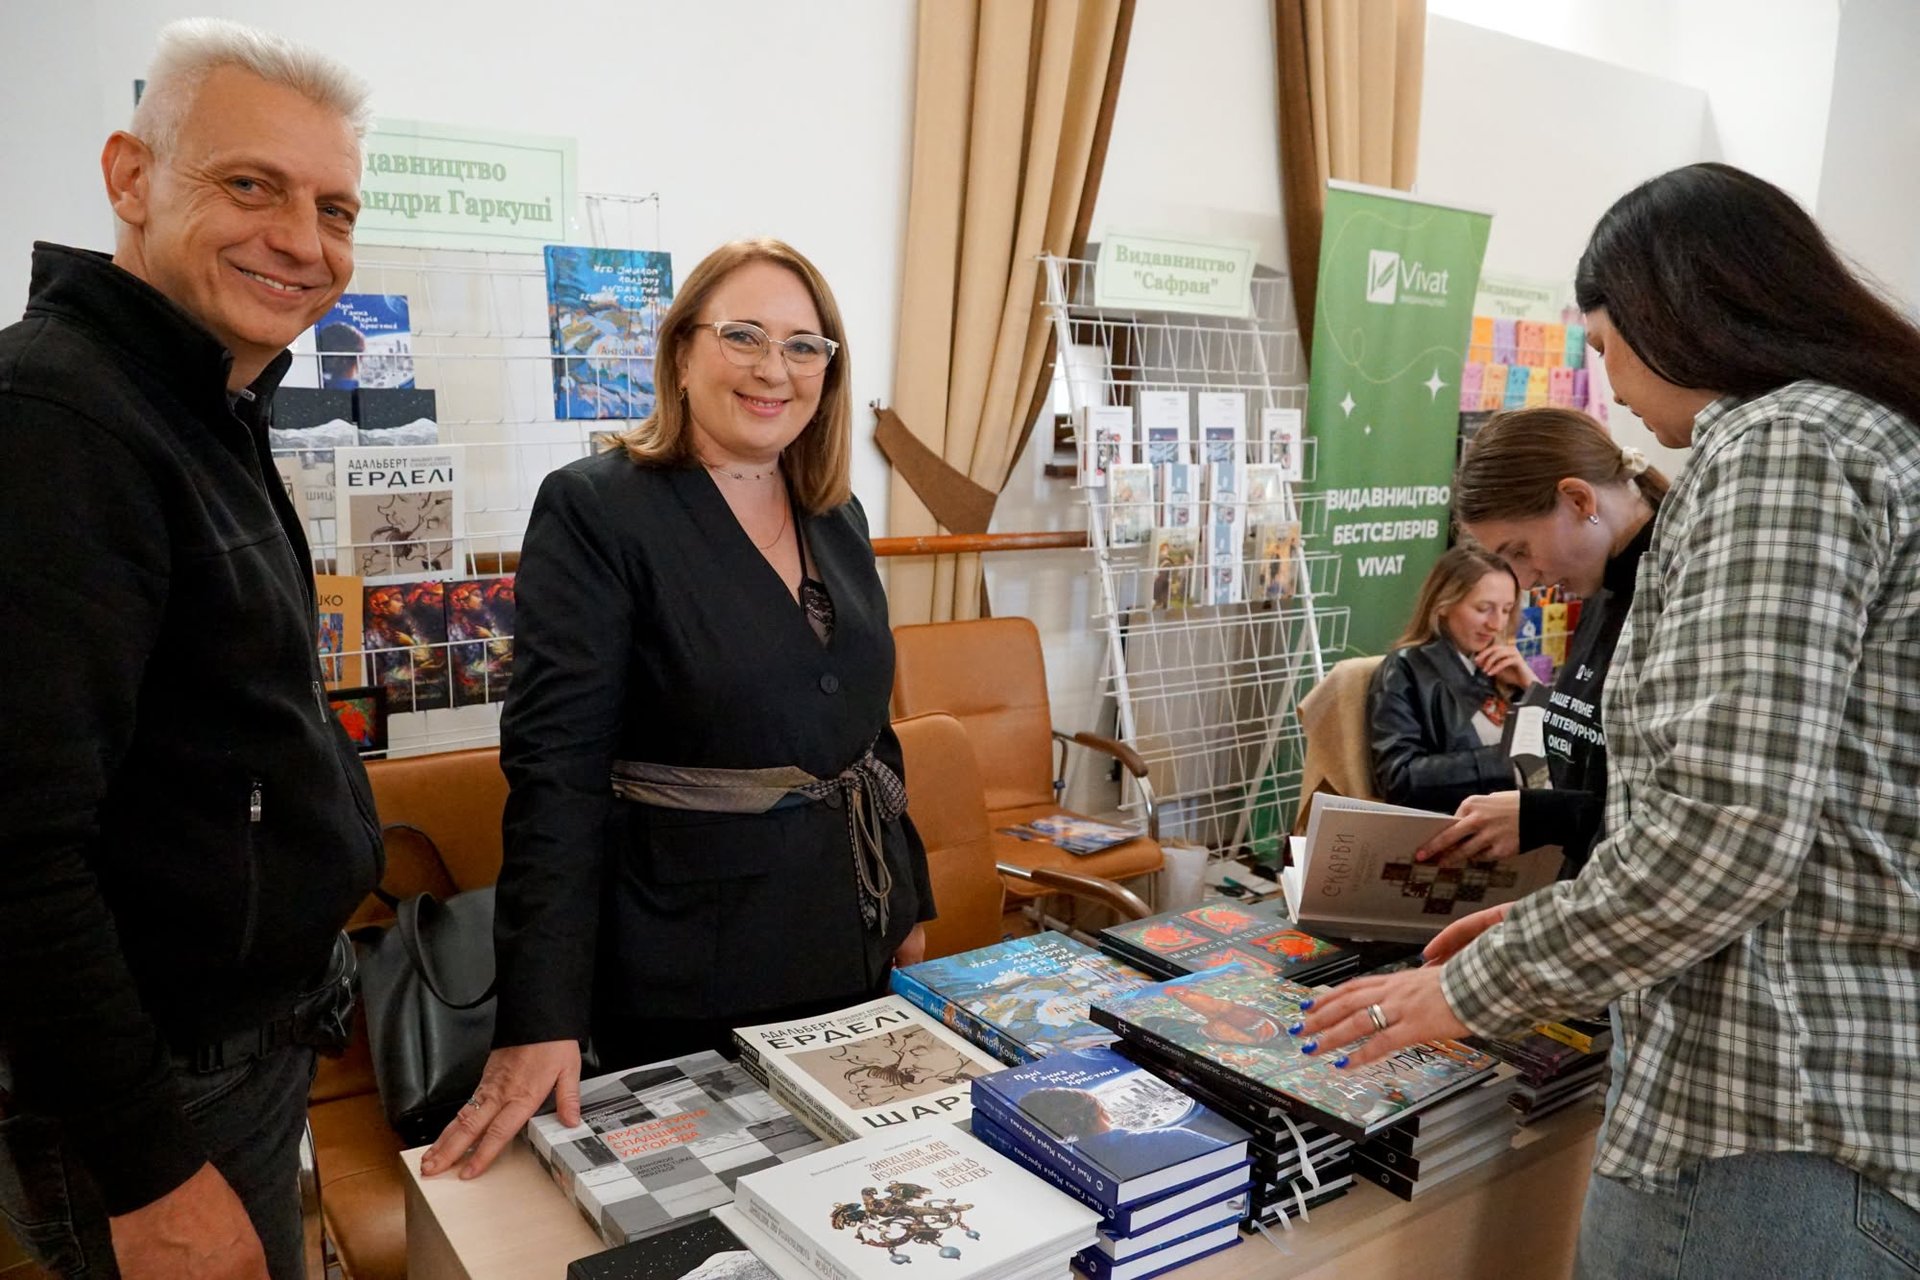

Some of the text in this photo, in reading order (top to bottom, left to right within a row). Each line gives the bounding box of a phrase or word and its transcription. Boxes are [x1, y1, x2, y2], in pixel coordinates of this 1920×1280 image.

[447, 189, 553, 225] Гаркуші
[1115, 243, 1236, 273] Видавництво
[1133, 270, 1219, 296] "Сафран"
[1400, 258, 1449, 295] Vivat
[348, 457, 408, 470] АДАЛЬБЕРТ
[347, 467, 454, 488] ЕРДЕЛІ
[1325, 485, 1451, 513] ВИДАВНИЦТВО
[1332, 518, 1440, 546] БЕСТСЕЛЕРІВ
[1357, 554, 1406, 578] VIVAT
[1321, 833, 1356, 898] СКАРБИ
[759, 1020, 837, 1039] АДАЛЬБЕРТ
[766, 1010, 911, 1050] ЕРДЕЛІ
[976, 1029, 1000, 1050] Anton
[1013, 1070, 1042, 1082] Пані
[1031, 1069, 1068, 1084] Ганна
[1049, 1070, 1087, 1085] Марія
[1066, 1066, 1121, 1087] Христина
[861, 1091, 972, 1129] ШАР
[612, 1121, 698, 1150] СПАДЩИНА
[618, 1130, 702, 1159] УЖГОРОДА
